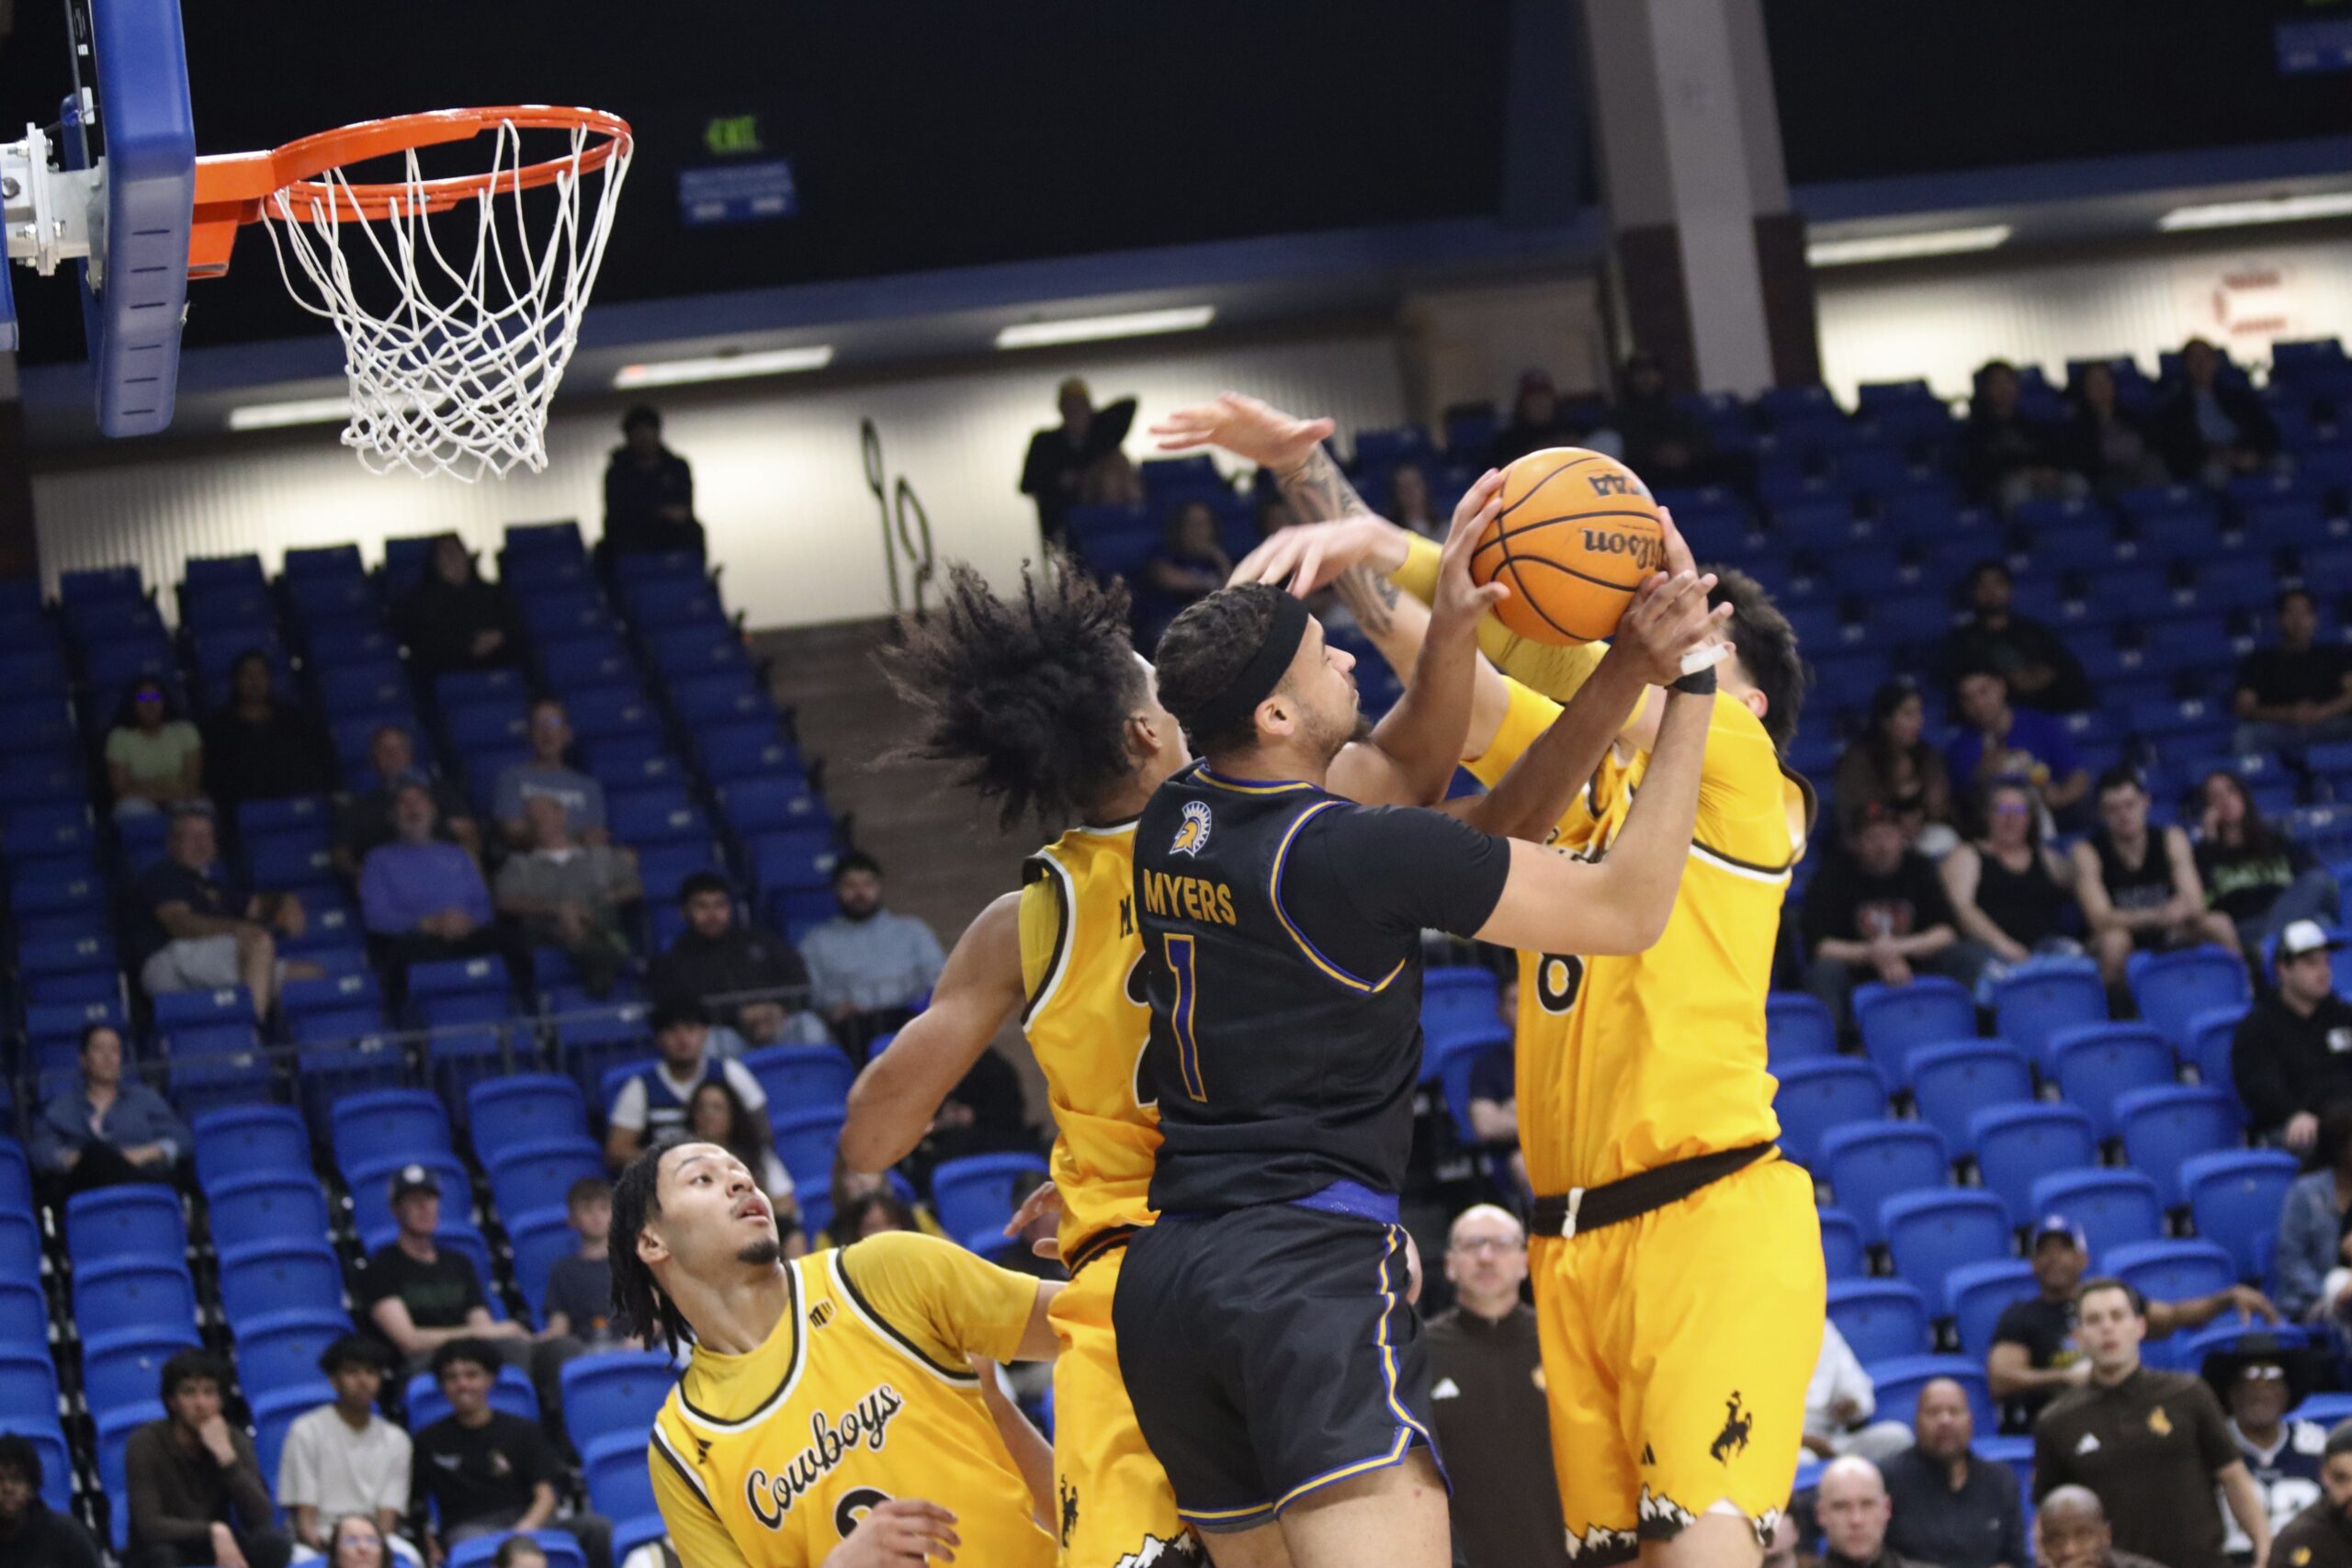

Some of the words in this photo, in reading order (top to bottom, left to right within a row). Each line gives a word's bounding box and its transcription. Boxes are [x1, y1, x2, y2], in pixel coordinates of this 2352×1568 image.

[1143, 868, 1237, 927] MYERS
[1163, 932, 1207, 1103] 1
[746, 1383, 905, 1530] Cowboys
